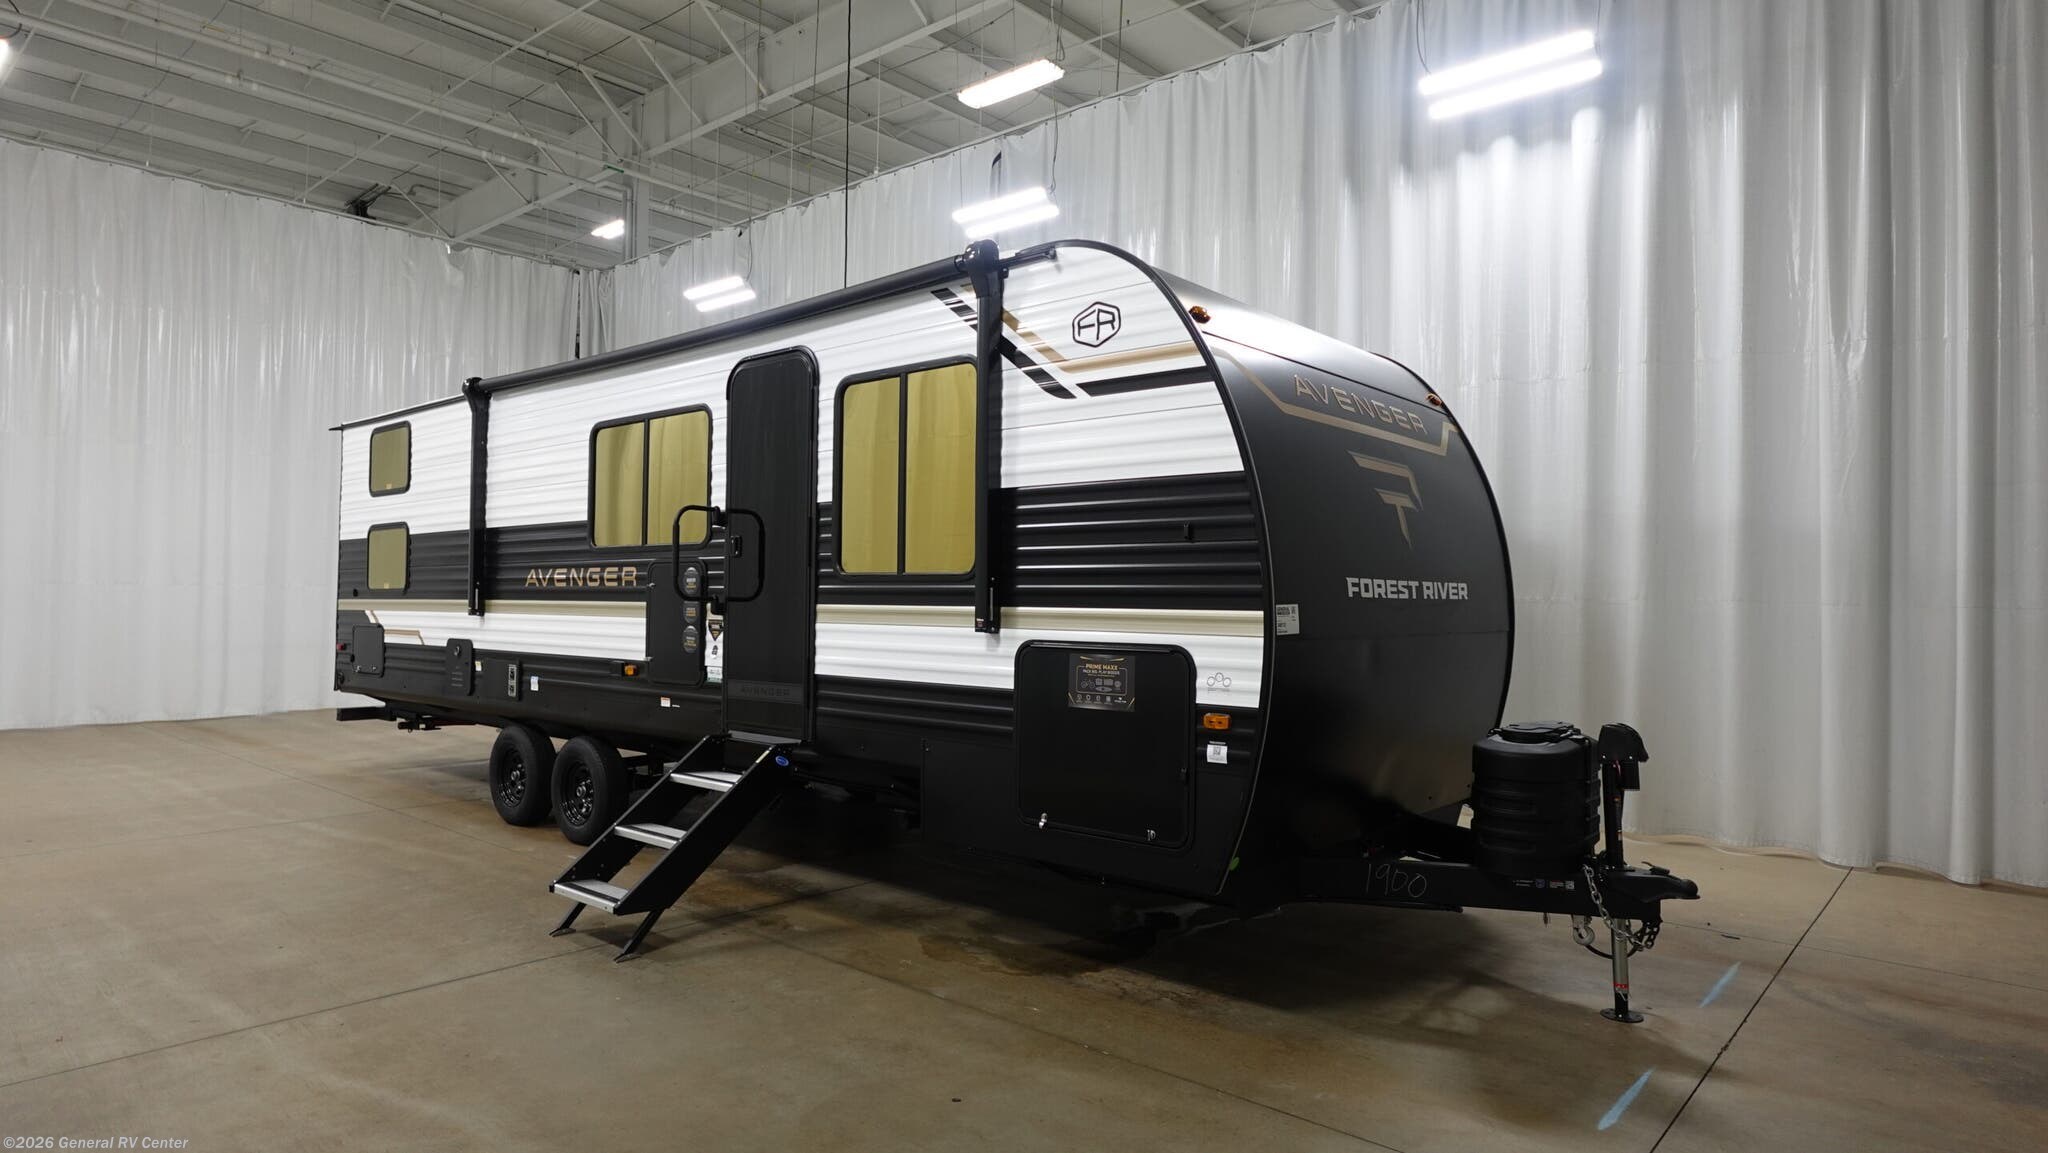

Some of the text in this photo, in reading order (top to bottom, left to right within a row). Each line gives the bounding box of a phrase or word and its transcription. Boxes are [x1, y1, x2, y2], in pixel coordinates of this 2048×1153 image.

[1293, 374, 1428, 434] AVENGER
[525, 566, 637, 587] AVENGER
[1346, 577, 1468, 600] FOREST RIVER
[1366, 863, 1427, 898] 1900
